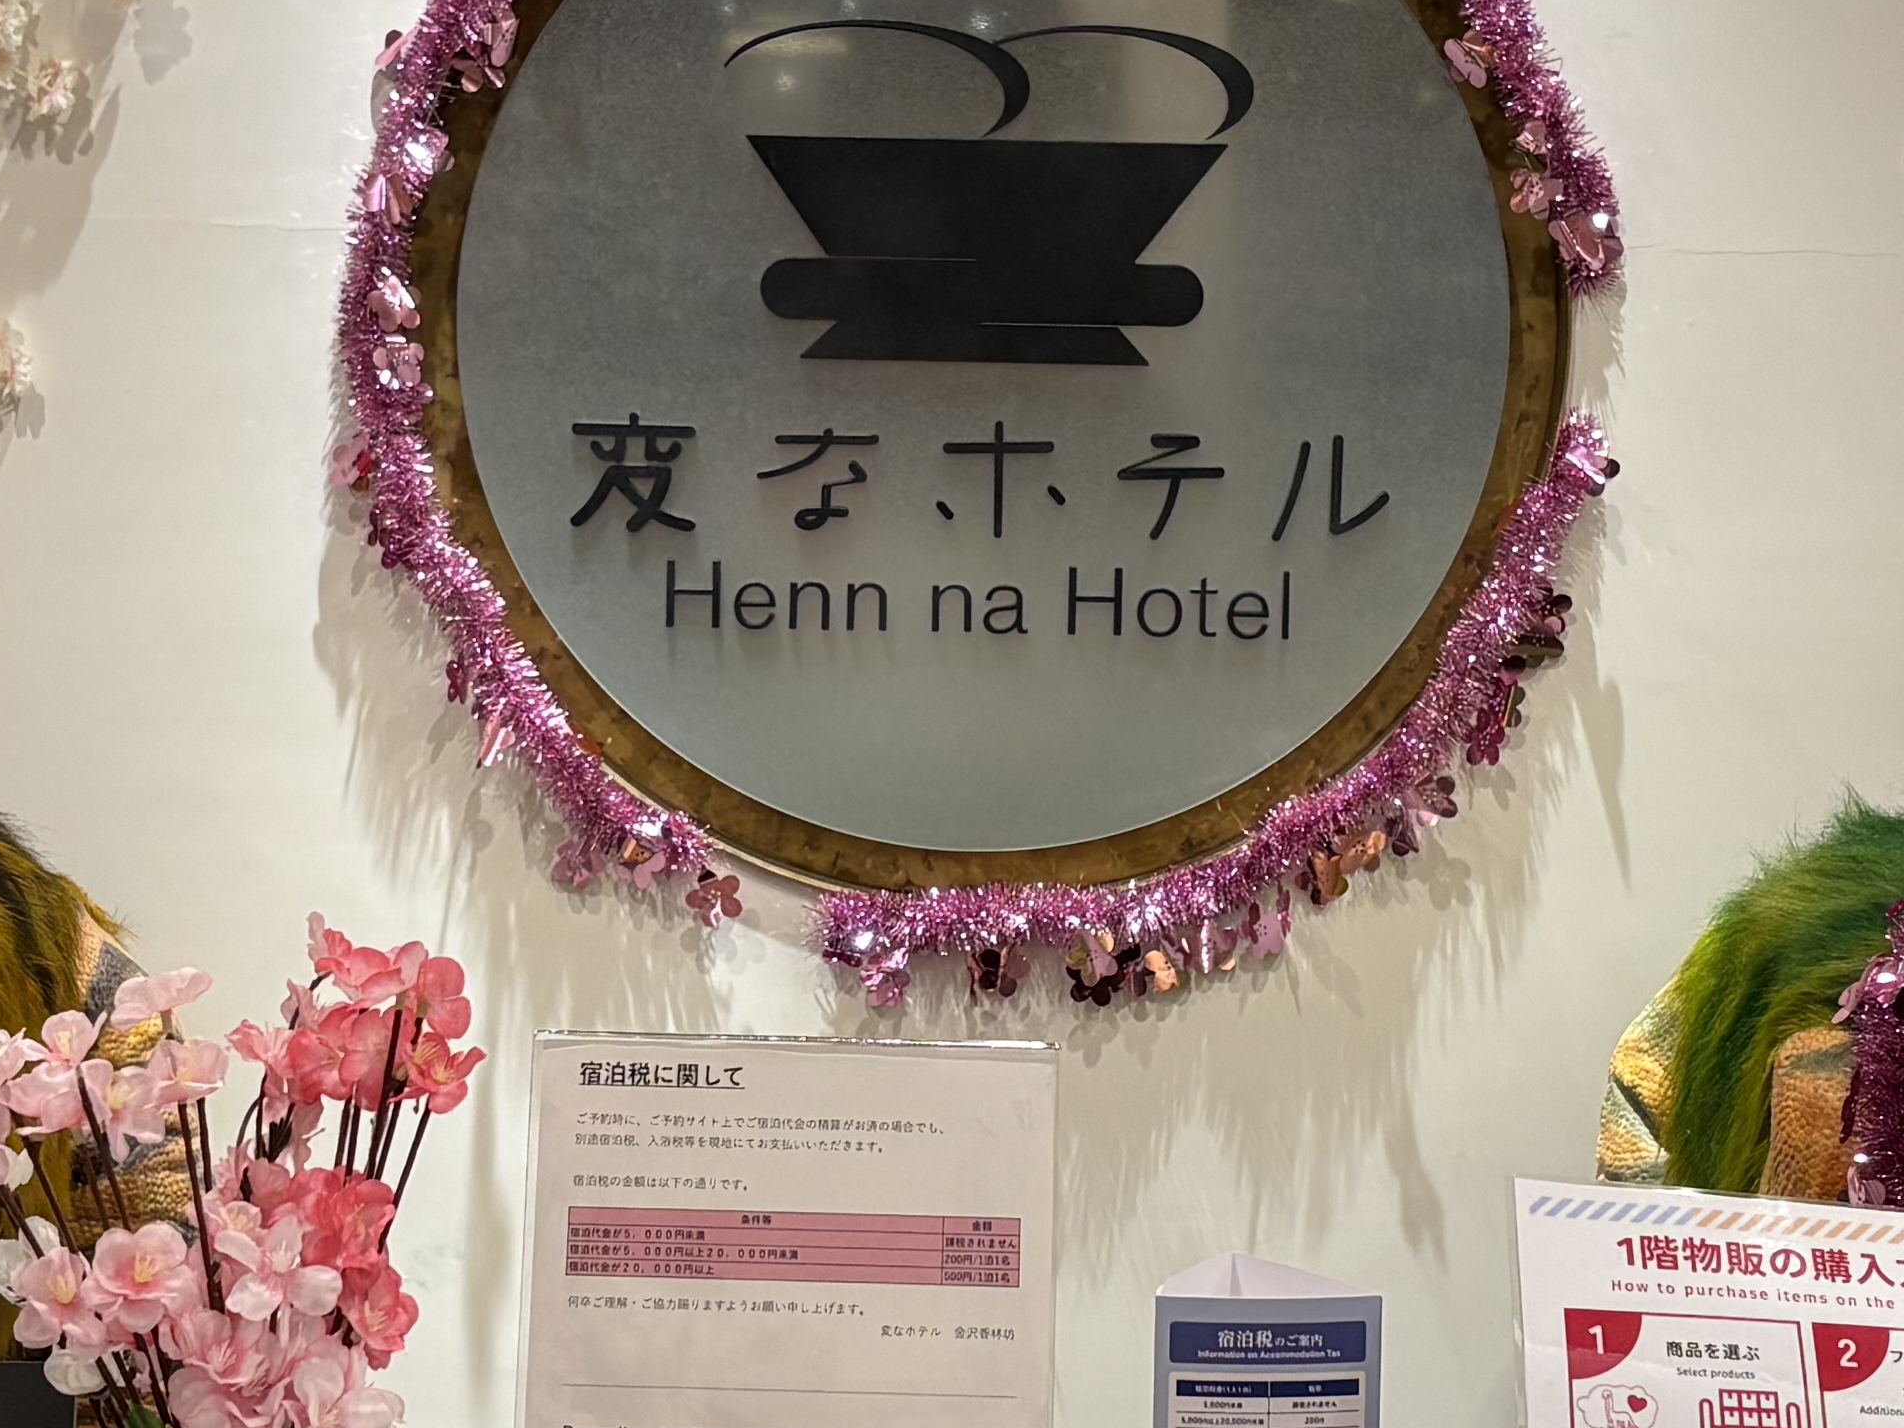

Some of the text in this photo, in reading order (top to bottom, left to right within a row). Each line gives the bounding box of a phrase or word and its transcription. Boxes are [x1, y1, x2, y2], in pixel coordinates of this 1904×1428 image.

[569, 410, 1390, 544] 変なホテル
[664, 558, 1290, 642] Henn na Hotel
[578, 1060, 744, 1089] 宿泊税に関して
[1611, 1279, 1648, 1292] How
[1656, 1282, 1675, 1294] to
[1684, 1284, 1768, 1300] purchase
[1776, 1288, 1827, 1304] items
[1835, 1295, 1856, 1306] on
[1865, 1295, 1894, 1309] the
[1588, 1324, 1604, 1354] 1
[1666, 1340, 1760, 1361] 商品を選ぶ
[1837, 1338, 1858, 1367] 2
[1676, 1366, 1755, 1379] Select products
